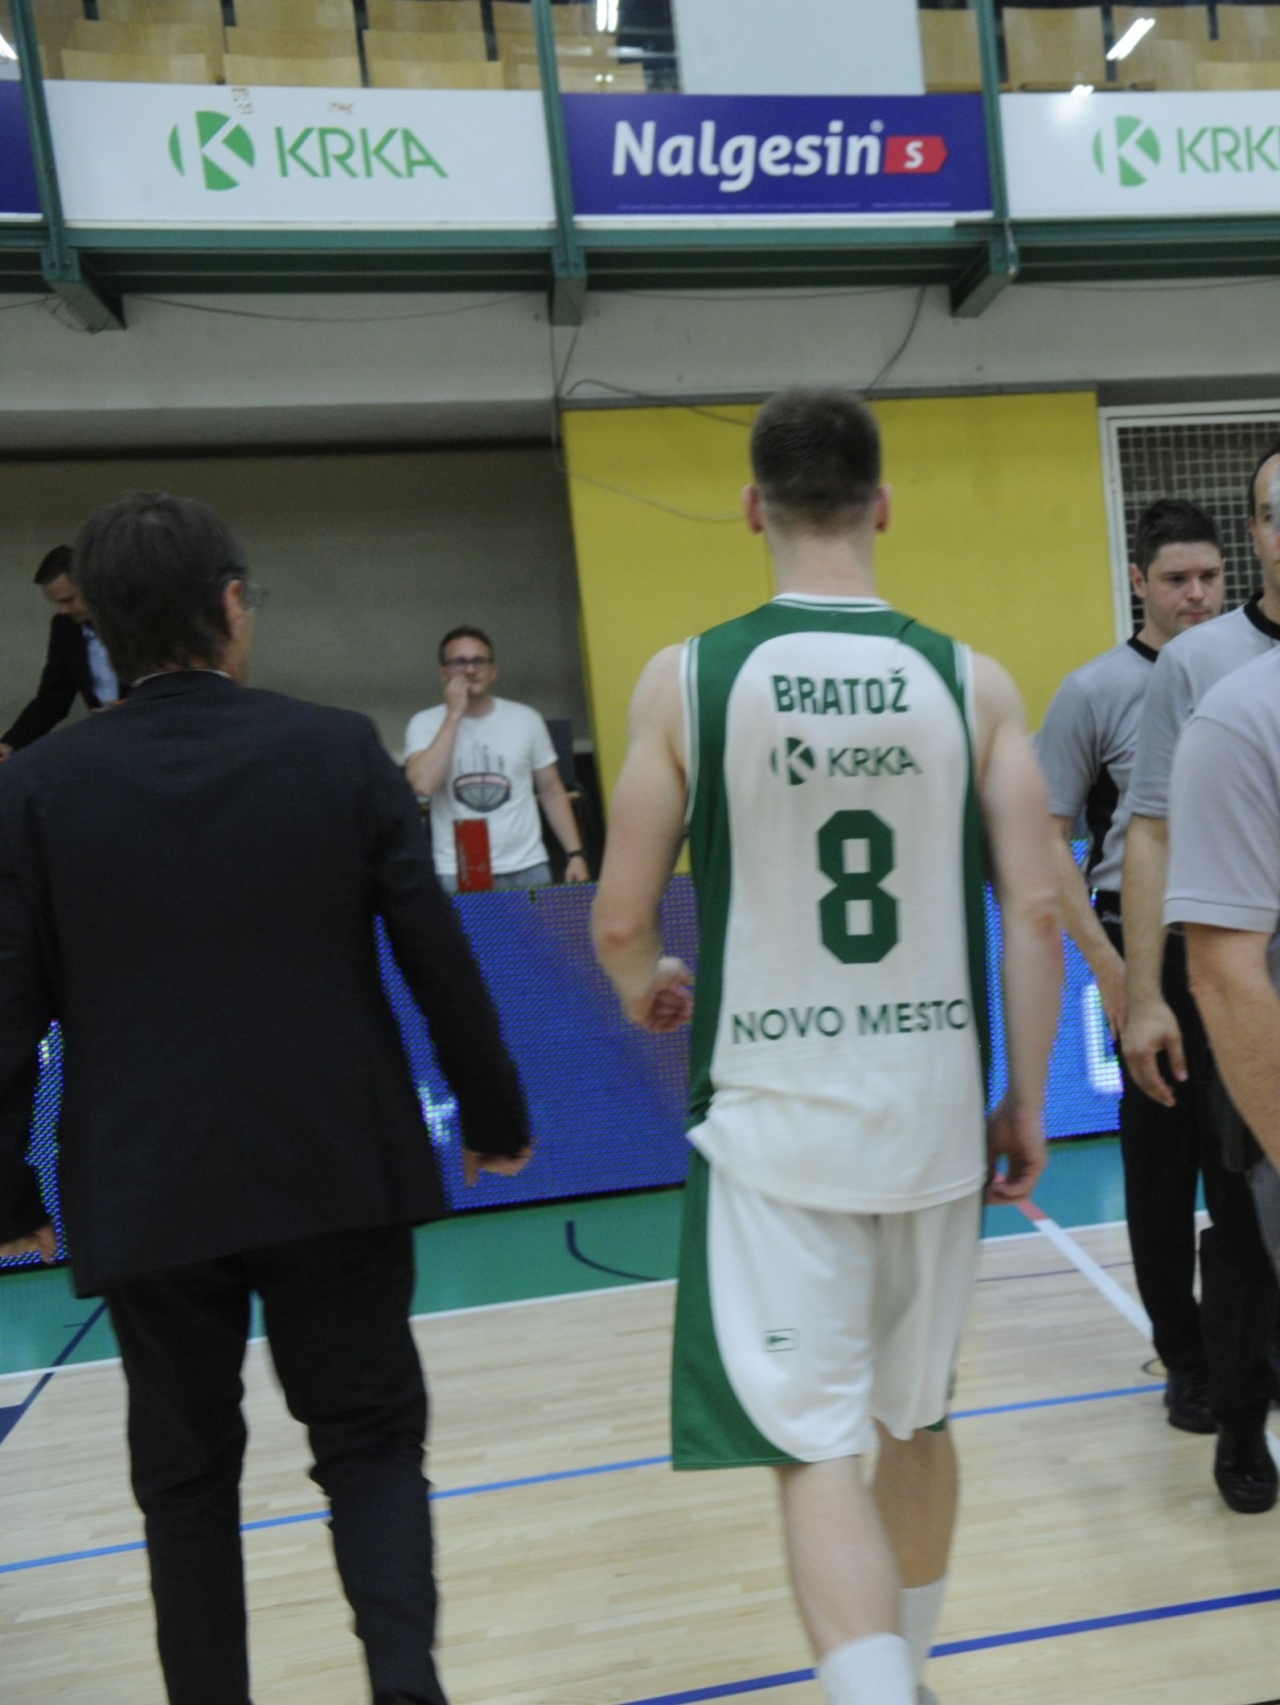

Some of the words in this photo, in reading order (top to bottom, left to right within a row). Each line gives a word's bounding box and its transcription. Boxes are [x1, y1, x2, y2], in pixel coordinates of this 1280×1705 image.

[273, 126, 449, 179] KRKA
[611, 119, 885, 193] Nalgesin
[771, 666, 910, 715] BRATOŽ
[827, 746, 923, 777] KRKA
[817, 809, 900, 965] 8
[732, 1005, 844, 1044] NOVO
[857, 999, 971, 1036] MESTO
